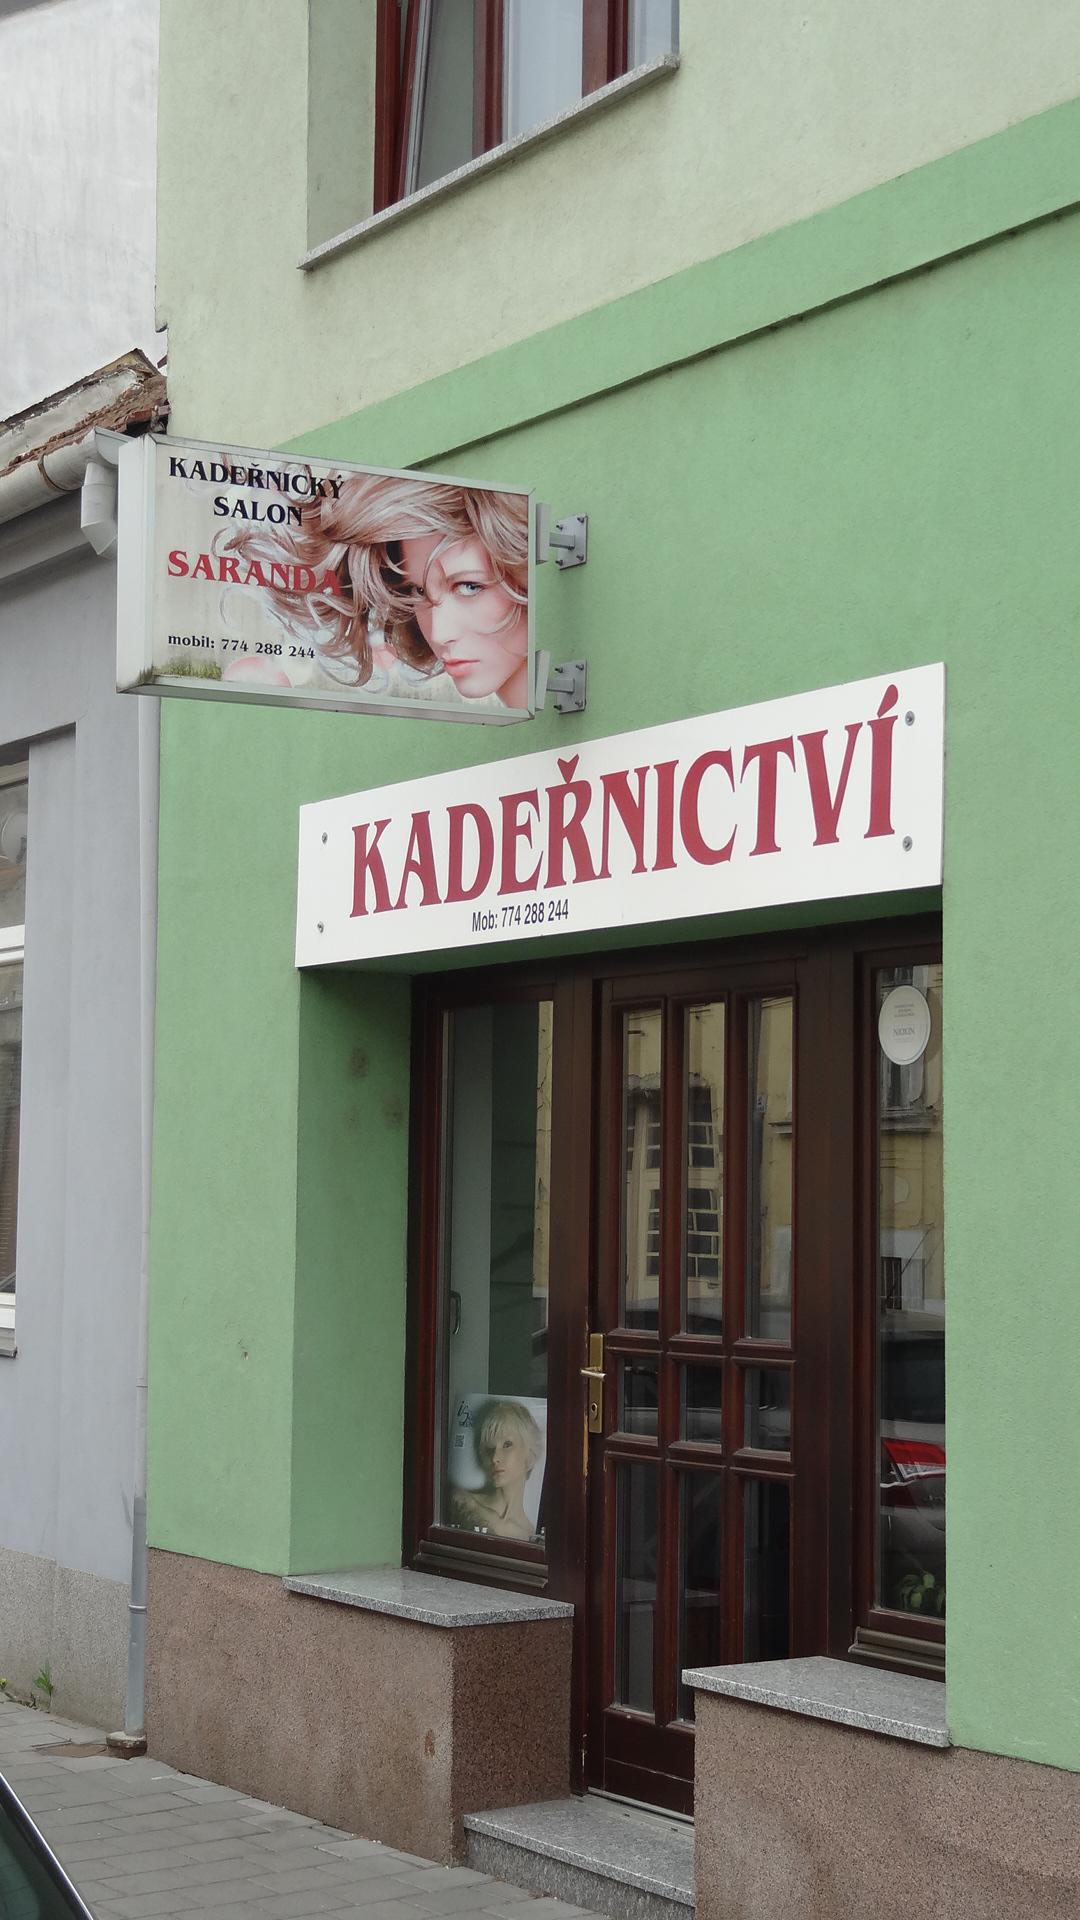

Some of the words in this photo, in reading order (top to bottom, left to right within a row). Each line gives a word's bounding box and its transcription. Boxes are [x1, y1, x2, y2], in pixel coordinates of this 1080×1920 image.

[169, 456, 345, 499] KADEŘNICKÝ
[214, 496, 302, 526] SALON
[167, 550, 342, 596] SARANDA
[168, 635, 215, 649] mobil:
[221, 639, 248, 652] 774
[255, 642, 282, 656] 288
[288, 645, 315, 659] 244
[350, 684, 899, 918] KADEŘNICTVÍ
[472, 910, 498, 932] Mob:
[501, 905, 521, 927] 774
[524, 902, 545, 925] 288
[548, 899, 569, 921] 244
